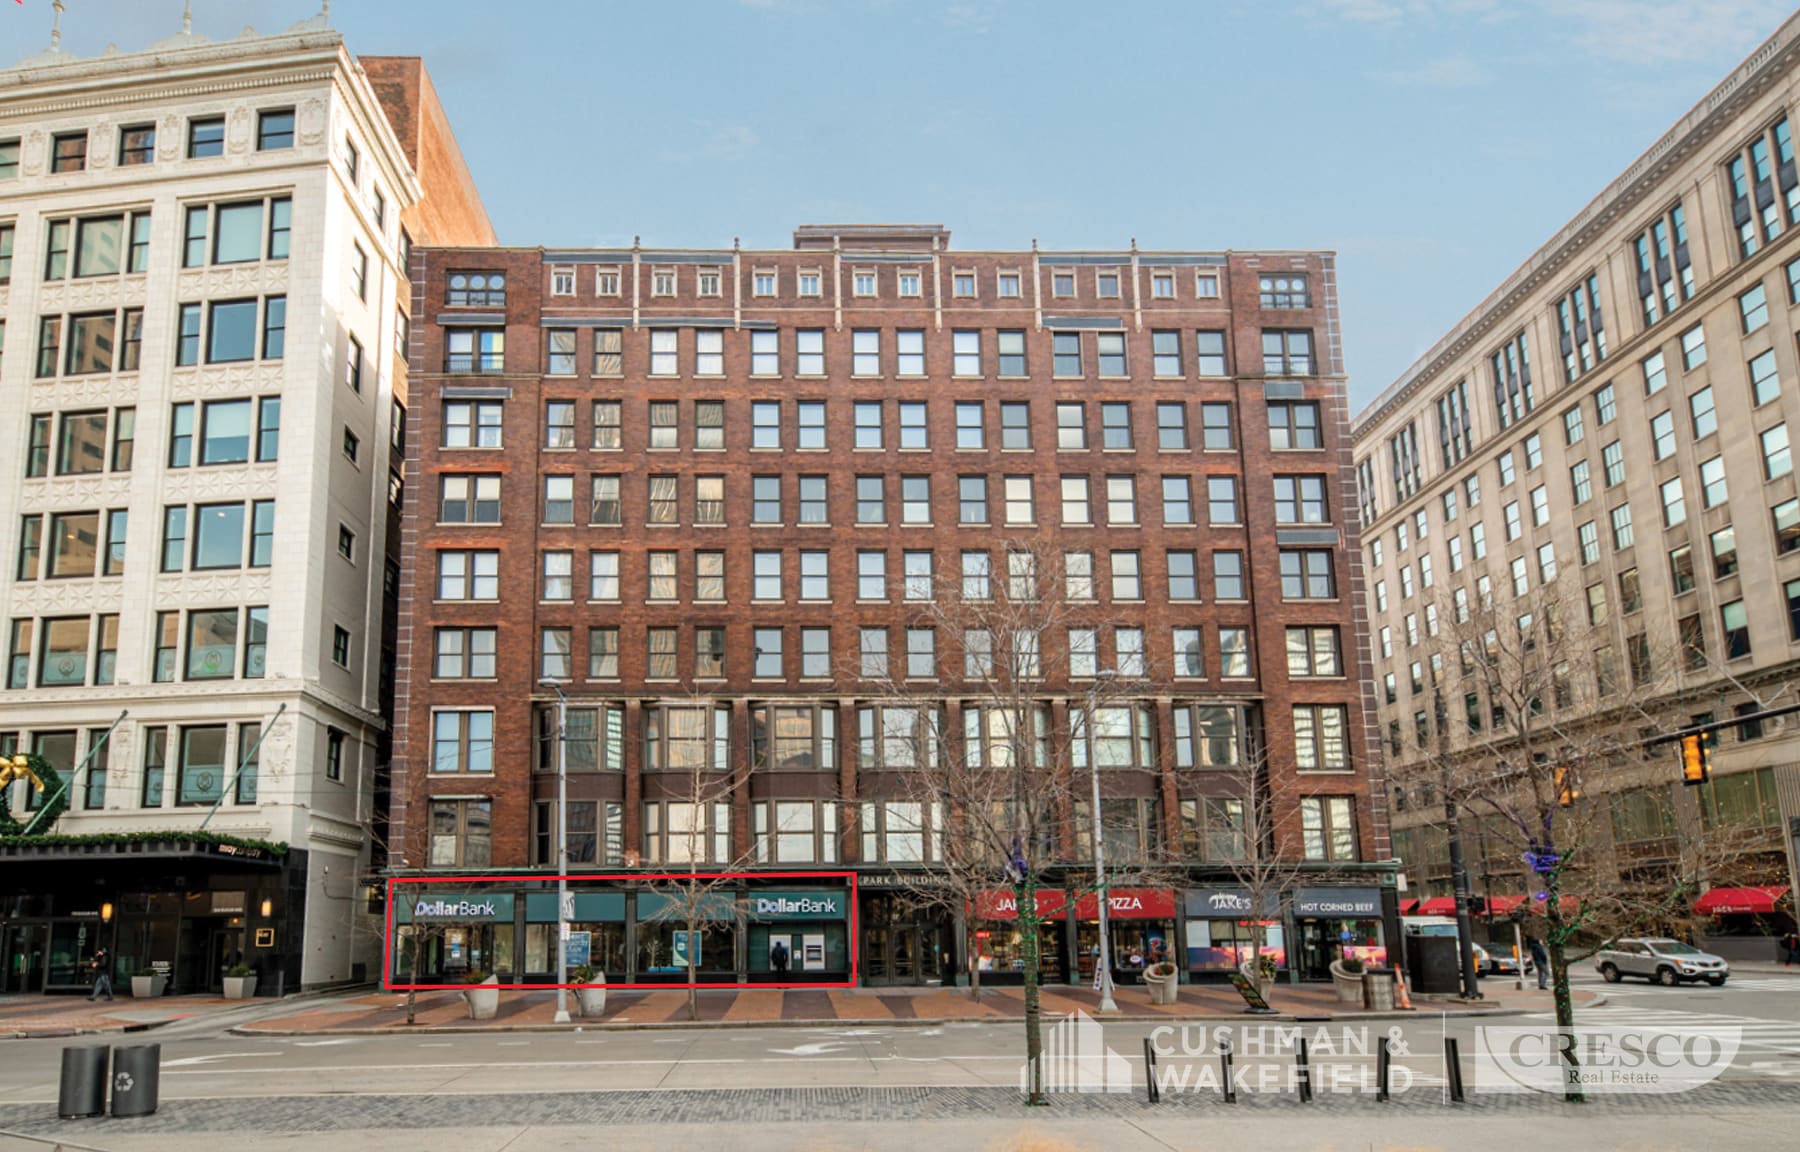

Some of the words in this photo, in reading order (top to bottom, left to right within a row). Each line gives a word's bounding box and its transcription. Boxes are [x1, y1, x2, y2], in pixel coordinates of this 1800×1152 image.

[863, 876, 890, 885] PARK
[414, 901, 494, 916] DollarBank
[757, 898, 836, 913] DollarBank
[1300, 903, 1318, 911] HOT
[1320, 903, 1353, 912] CORNED
[1355, 903, 1374, 911] BEEF
